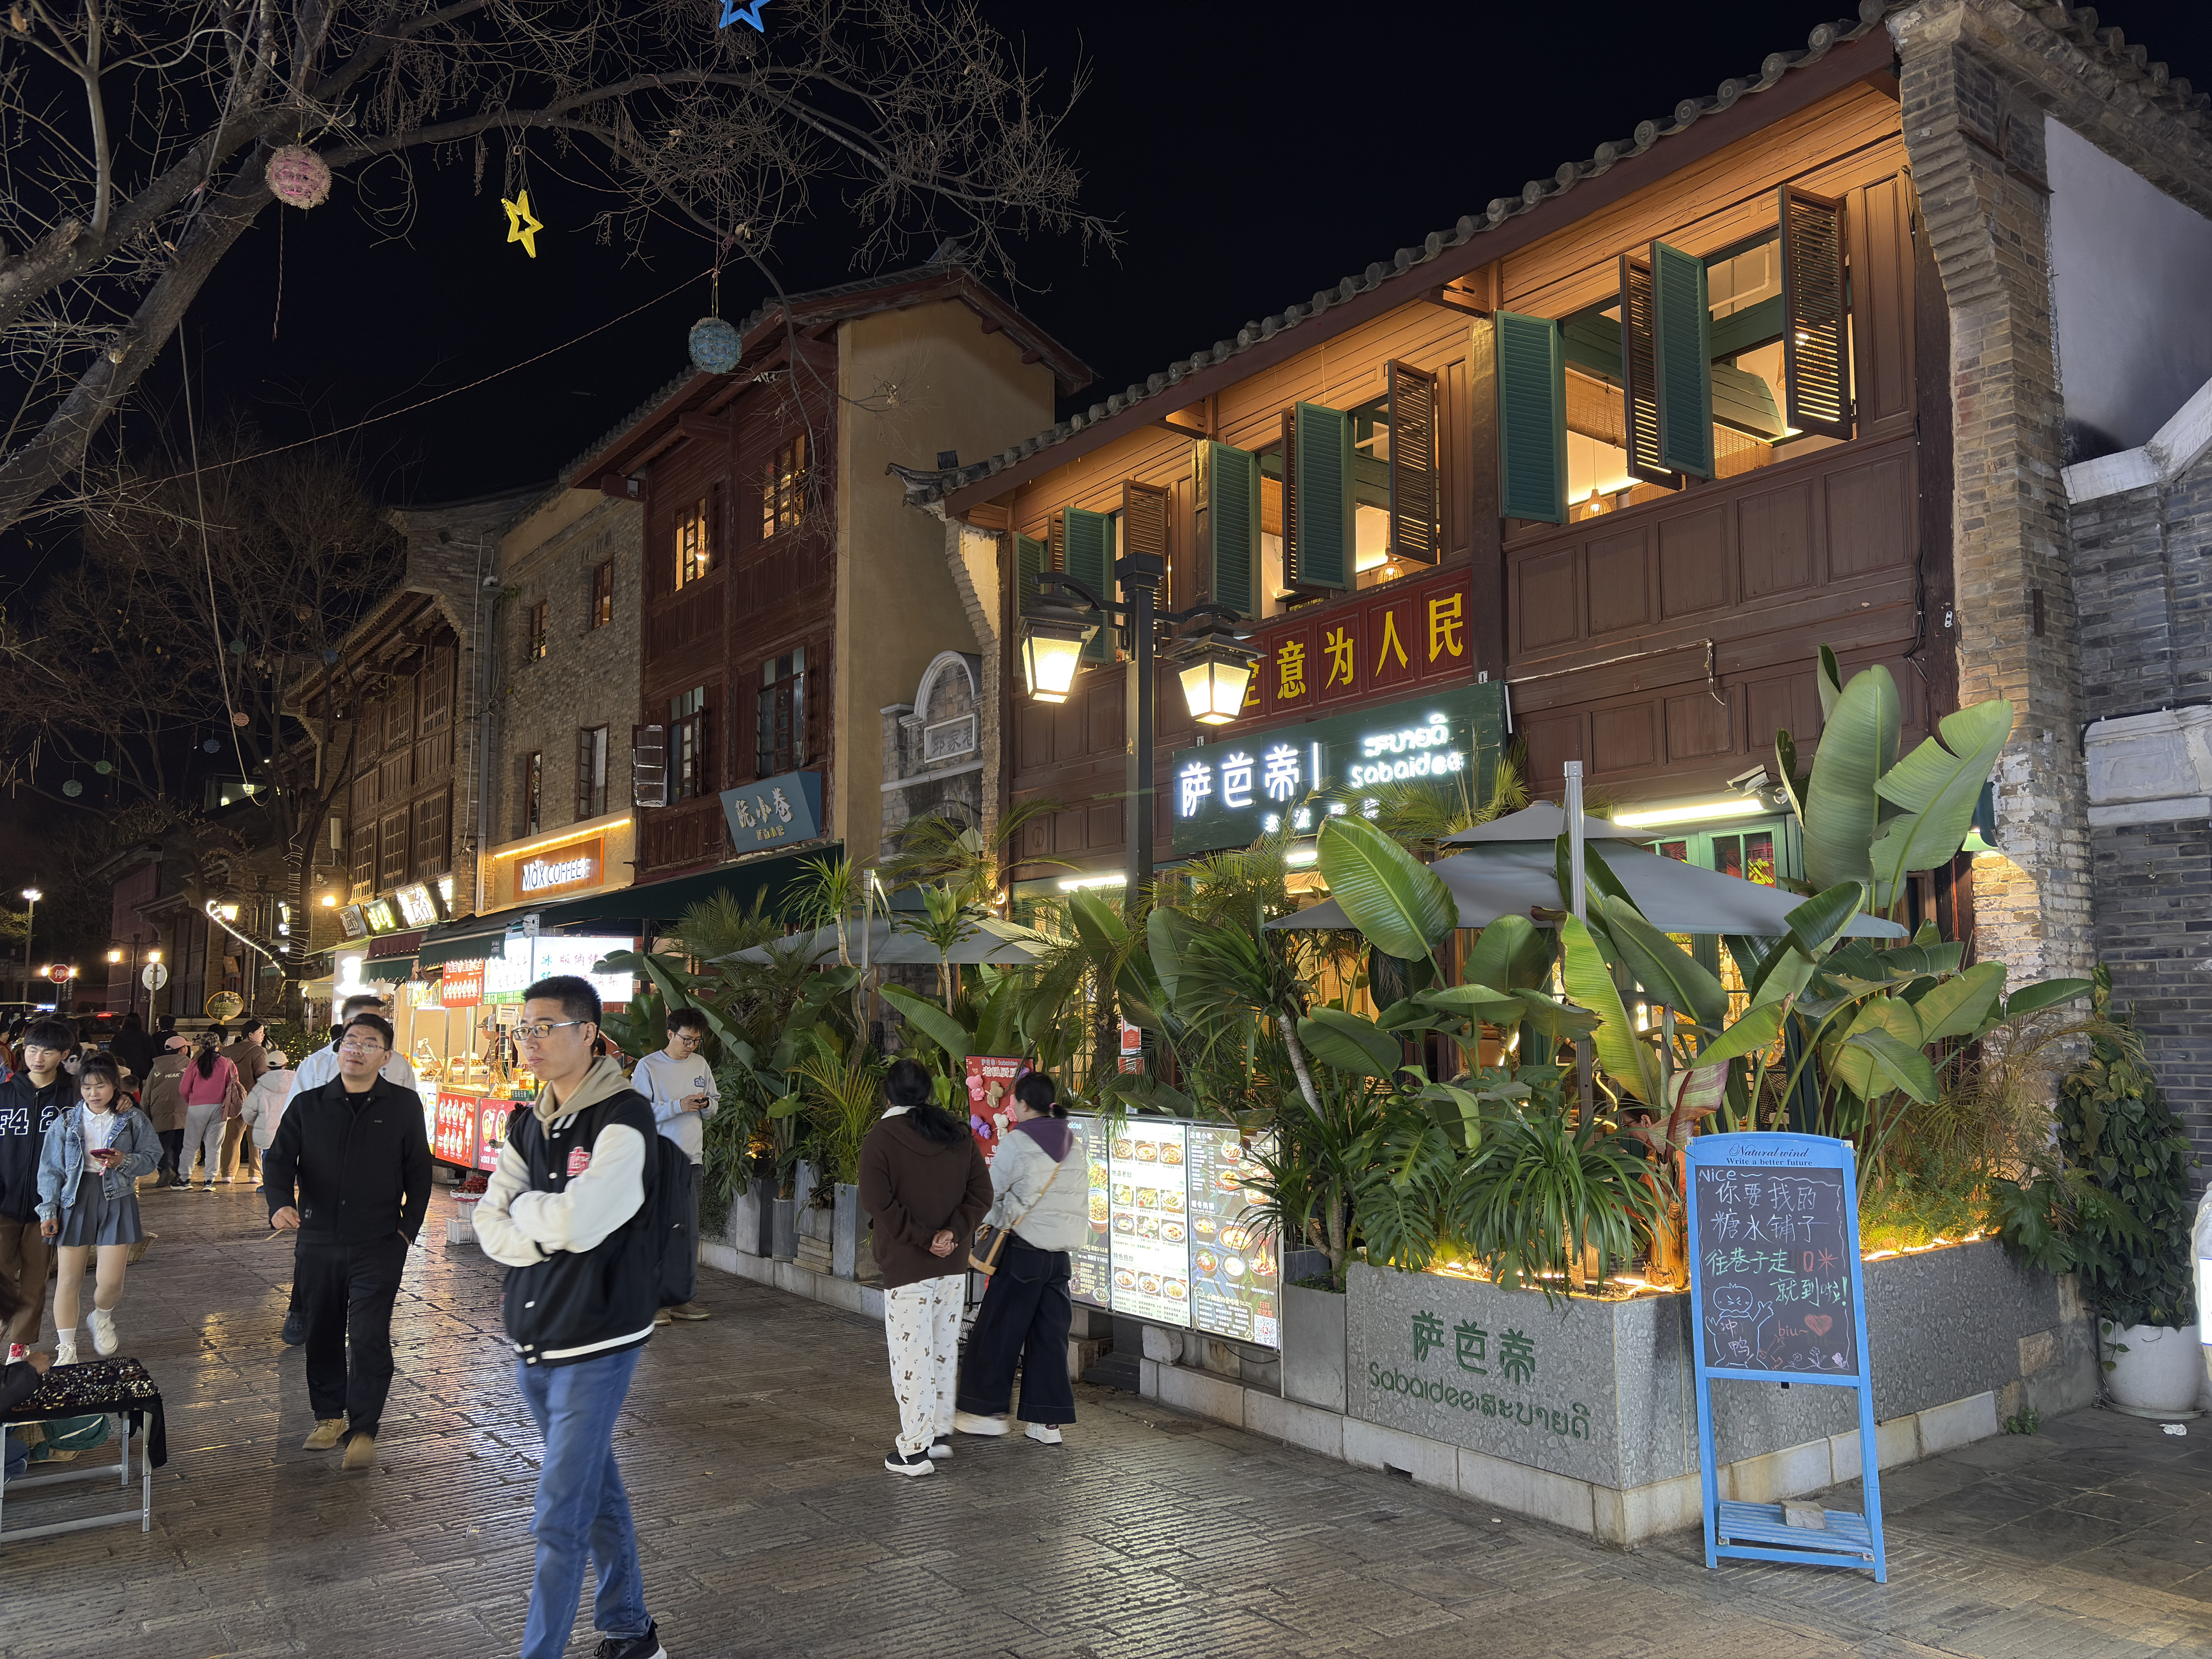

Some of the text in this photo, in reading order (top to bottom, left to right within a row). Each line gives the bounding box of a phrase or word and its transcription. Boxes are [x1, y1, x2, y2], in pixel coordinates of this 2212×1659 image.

[1180, 744, 1301, 817] 萨芭蒂
[547, 858, 592, 886] COFFEE
[54, 969, 65, 979] 停
[39, 1106, 75, 1133] 2
[1729, 1143, 1809, 1157] Natural wind
[1715, 1181, 1816, 1212] 你要找的
[1711, 1208, 1829, 1243] 糖水铺子
[1259, 1301, 1270, 1310] 扫码
[1770, 1276, 1848, 1307] 就到啦!
[1257, 1308, 1273, 1317] 享优惠
[1720, 1319, 1738, 1338] 冲
[1411, 1310, 1535, 1385] 萨芭蒂
[1369, 1361, 1475, 1411] Sabaidee
